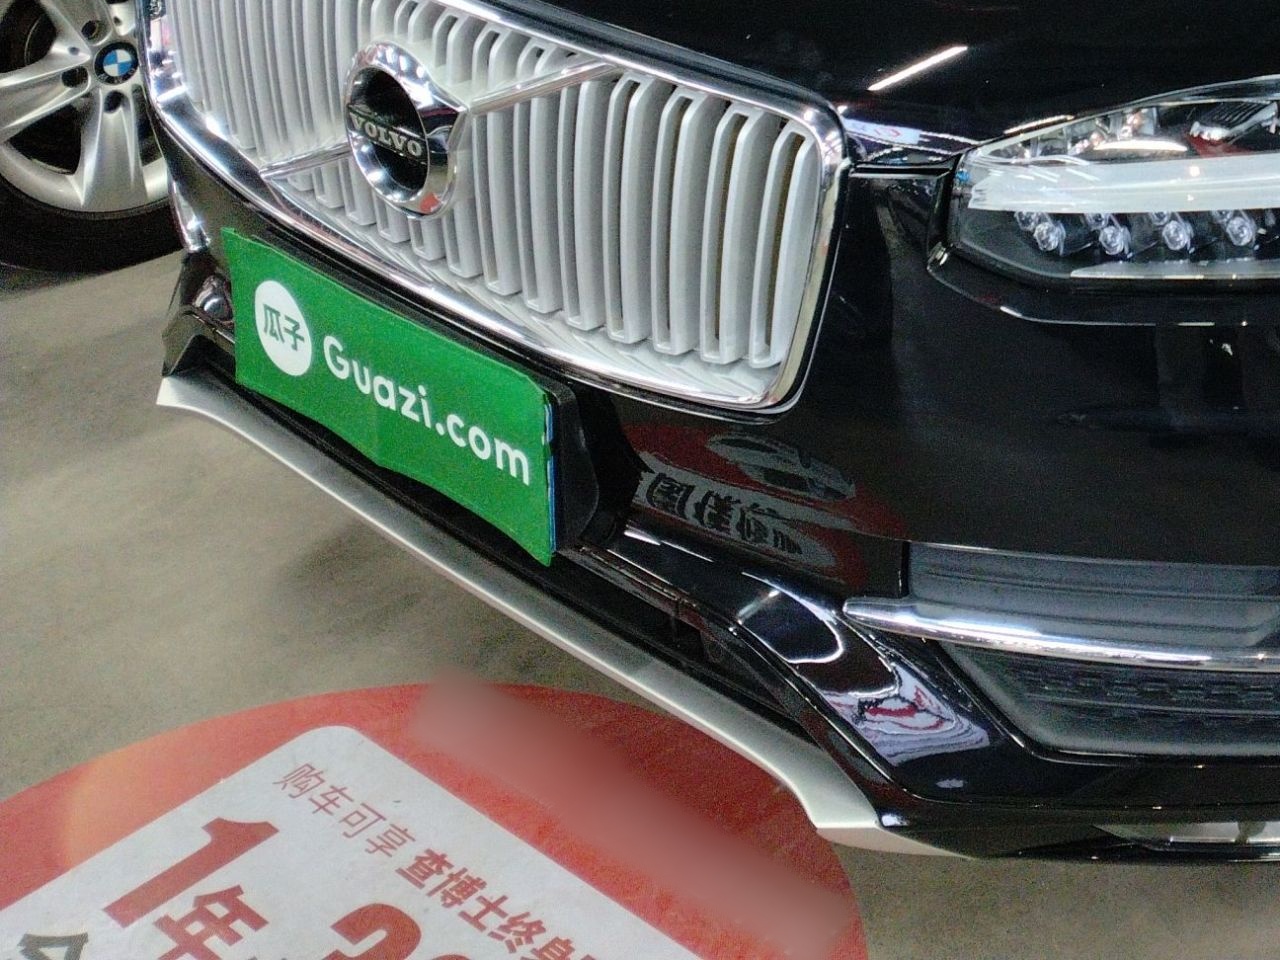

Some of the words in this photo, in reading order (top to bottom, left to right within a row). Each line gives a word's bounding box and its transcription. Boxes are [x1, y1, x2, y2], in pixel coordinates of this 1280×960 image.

[349, 111, 422, 157] VOLVO
[262, 303, 305, 352] 瓜子
[323, 335, 530, 486] Guazi.com
[102, 817, 281, 960] 1年
[273, 762, 416, 858] 购车可享
[395, 848, 599, 960] 查博士终身
